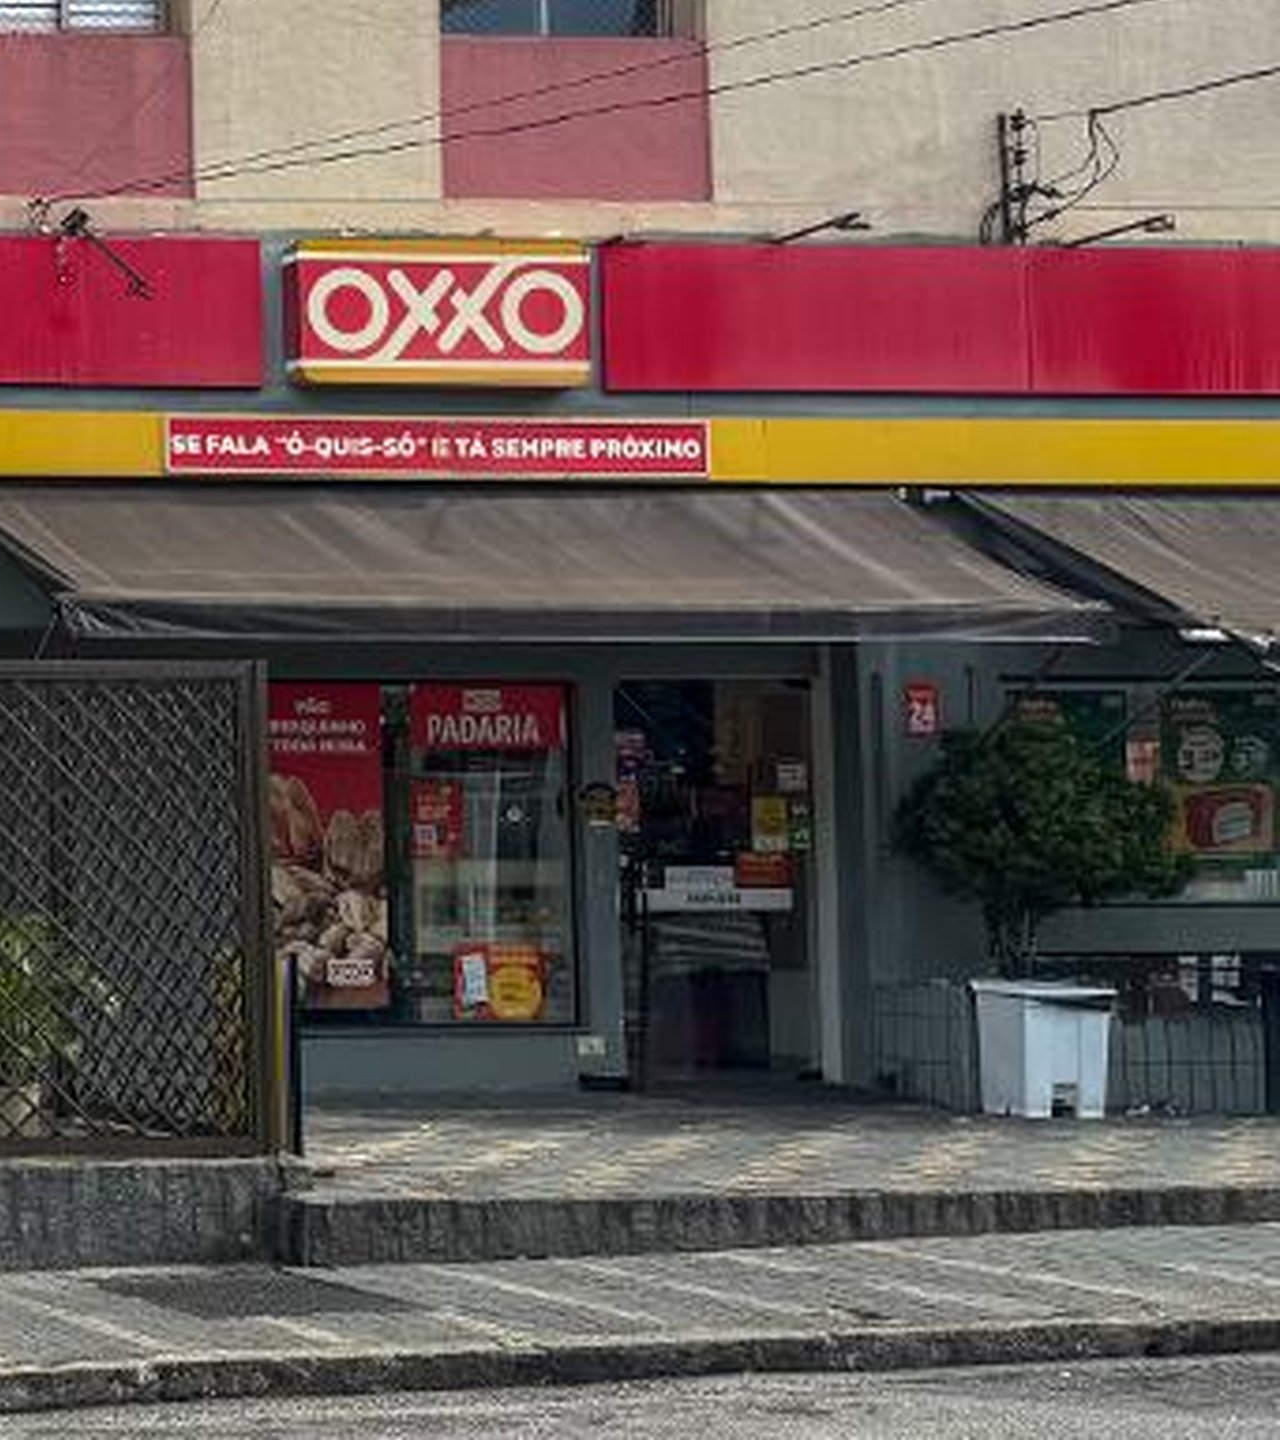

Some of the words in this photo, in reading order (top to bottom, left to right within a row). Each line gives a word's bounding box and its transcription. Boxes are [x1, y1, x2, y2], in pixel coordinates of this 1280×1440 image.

[308, 258, 585, 362] OXXO
[172, 434, 201, 455] SE
[206, 434, 271, 456] FALA
[431, 437, 450, 458] E
[454, 430, 488, 458] TÁ
[491, 437, 587, 459] SEMPRE
[589, 433, 702, 459] PRÓXIMO
[426, 713, 541, 746] PADARIA
